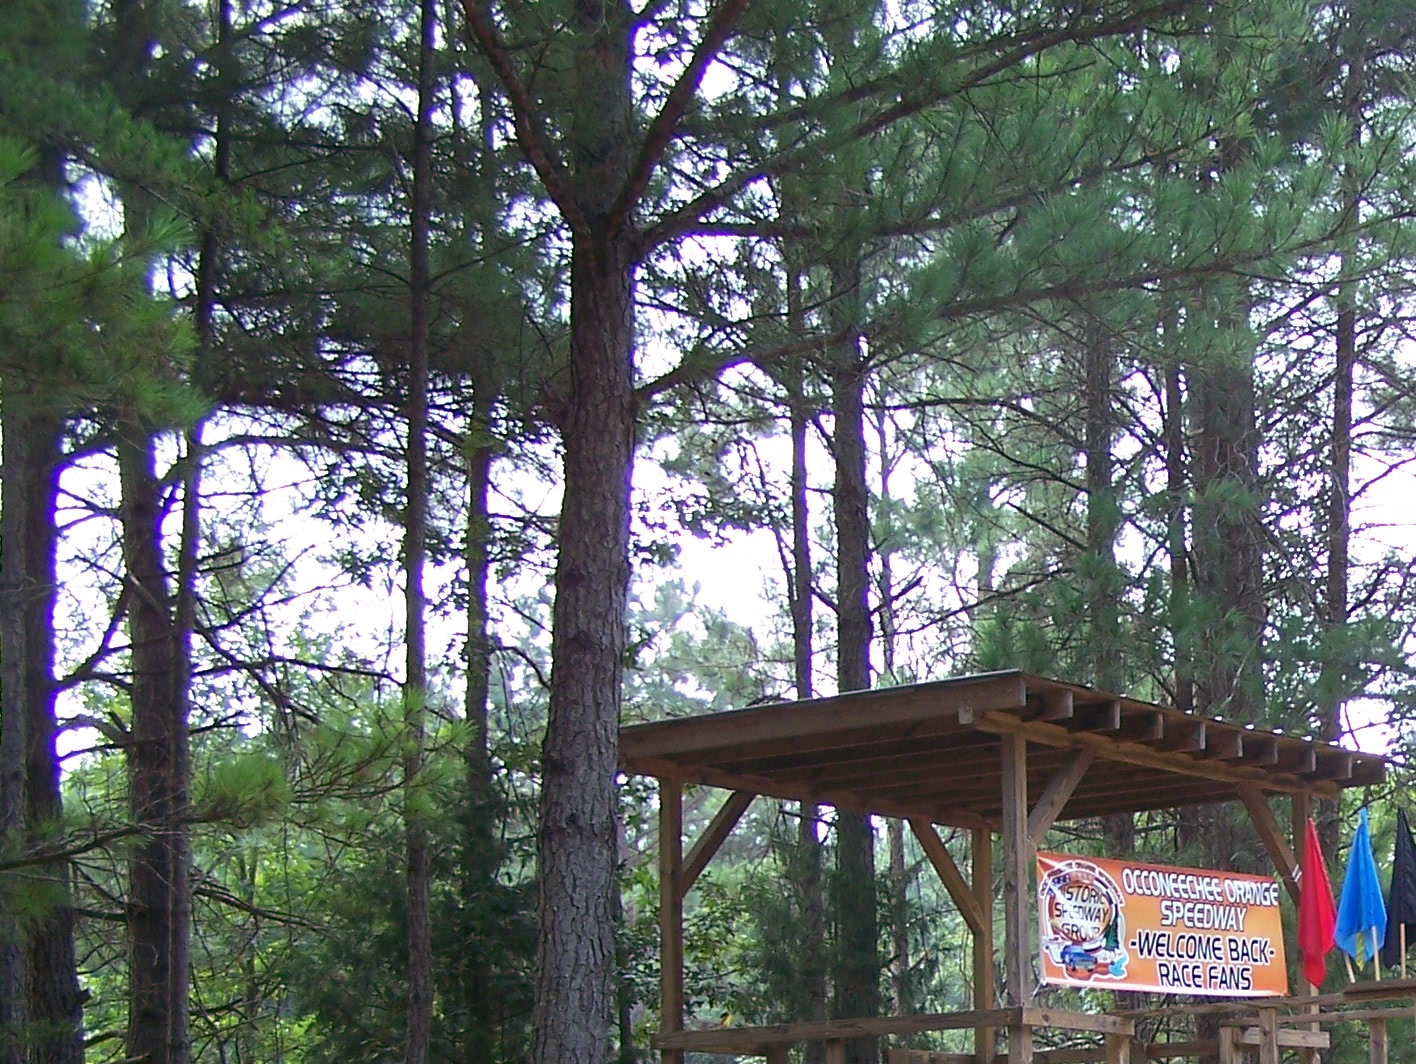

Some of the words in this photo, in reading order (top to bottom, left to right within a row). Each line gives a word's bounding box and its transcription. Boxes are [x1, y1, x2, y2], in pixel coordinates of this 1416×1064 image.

[1122, 868, 1223, 902] OCCONEECHEE
[1224, 878, 1278, 906] ORANGE
[1161, 900, 1247, 932] SPEEDWAY
[1158, 962, 1202, 988] RACE
[1208, 966, 1252, 991] FANS
